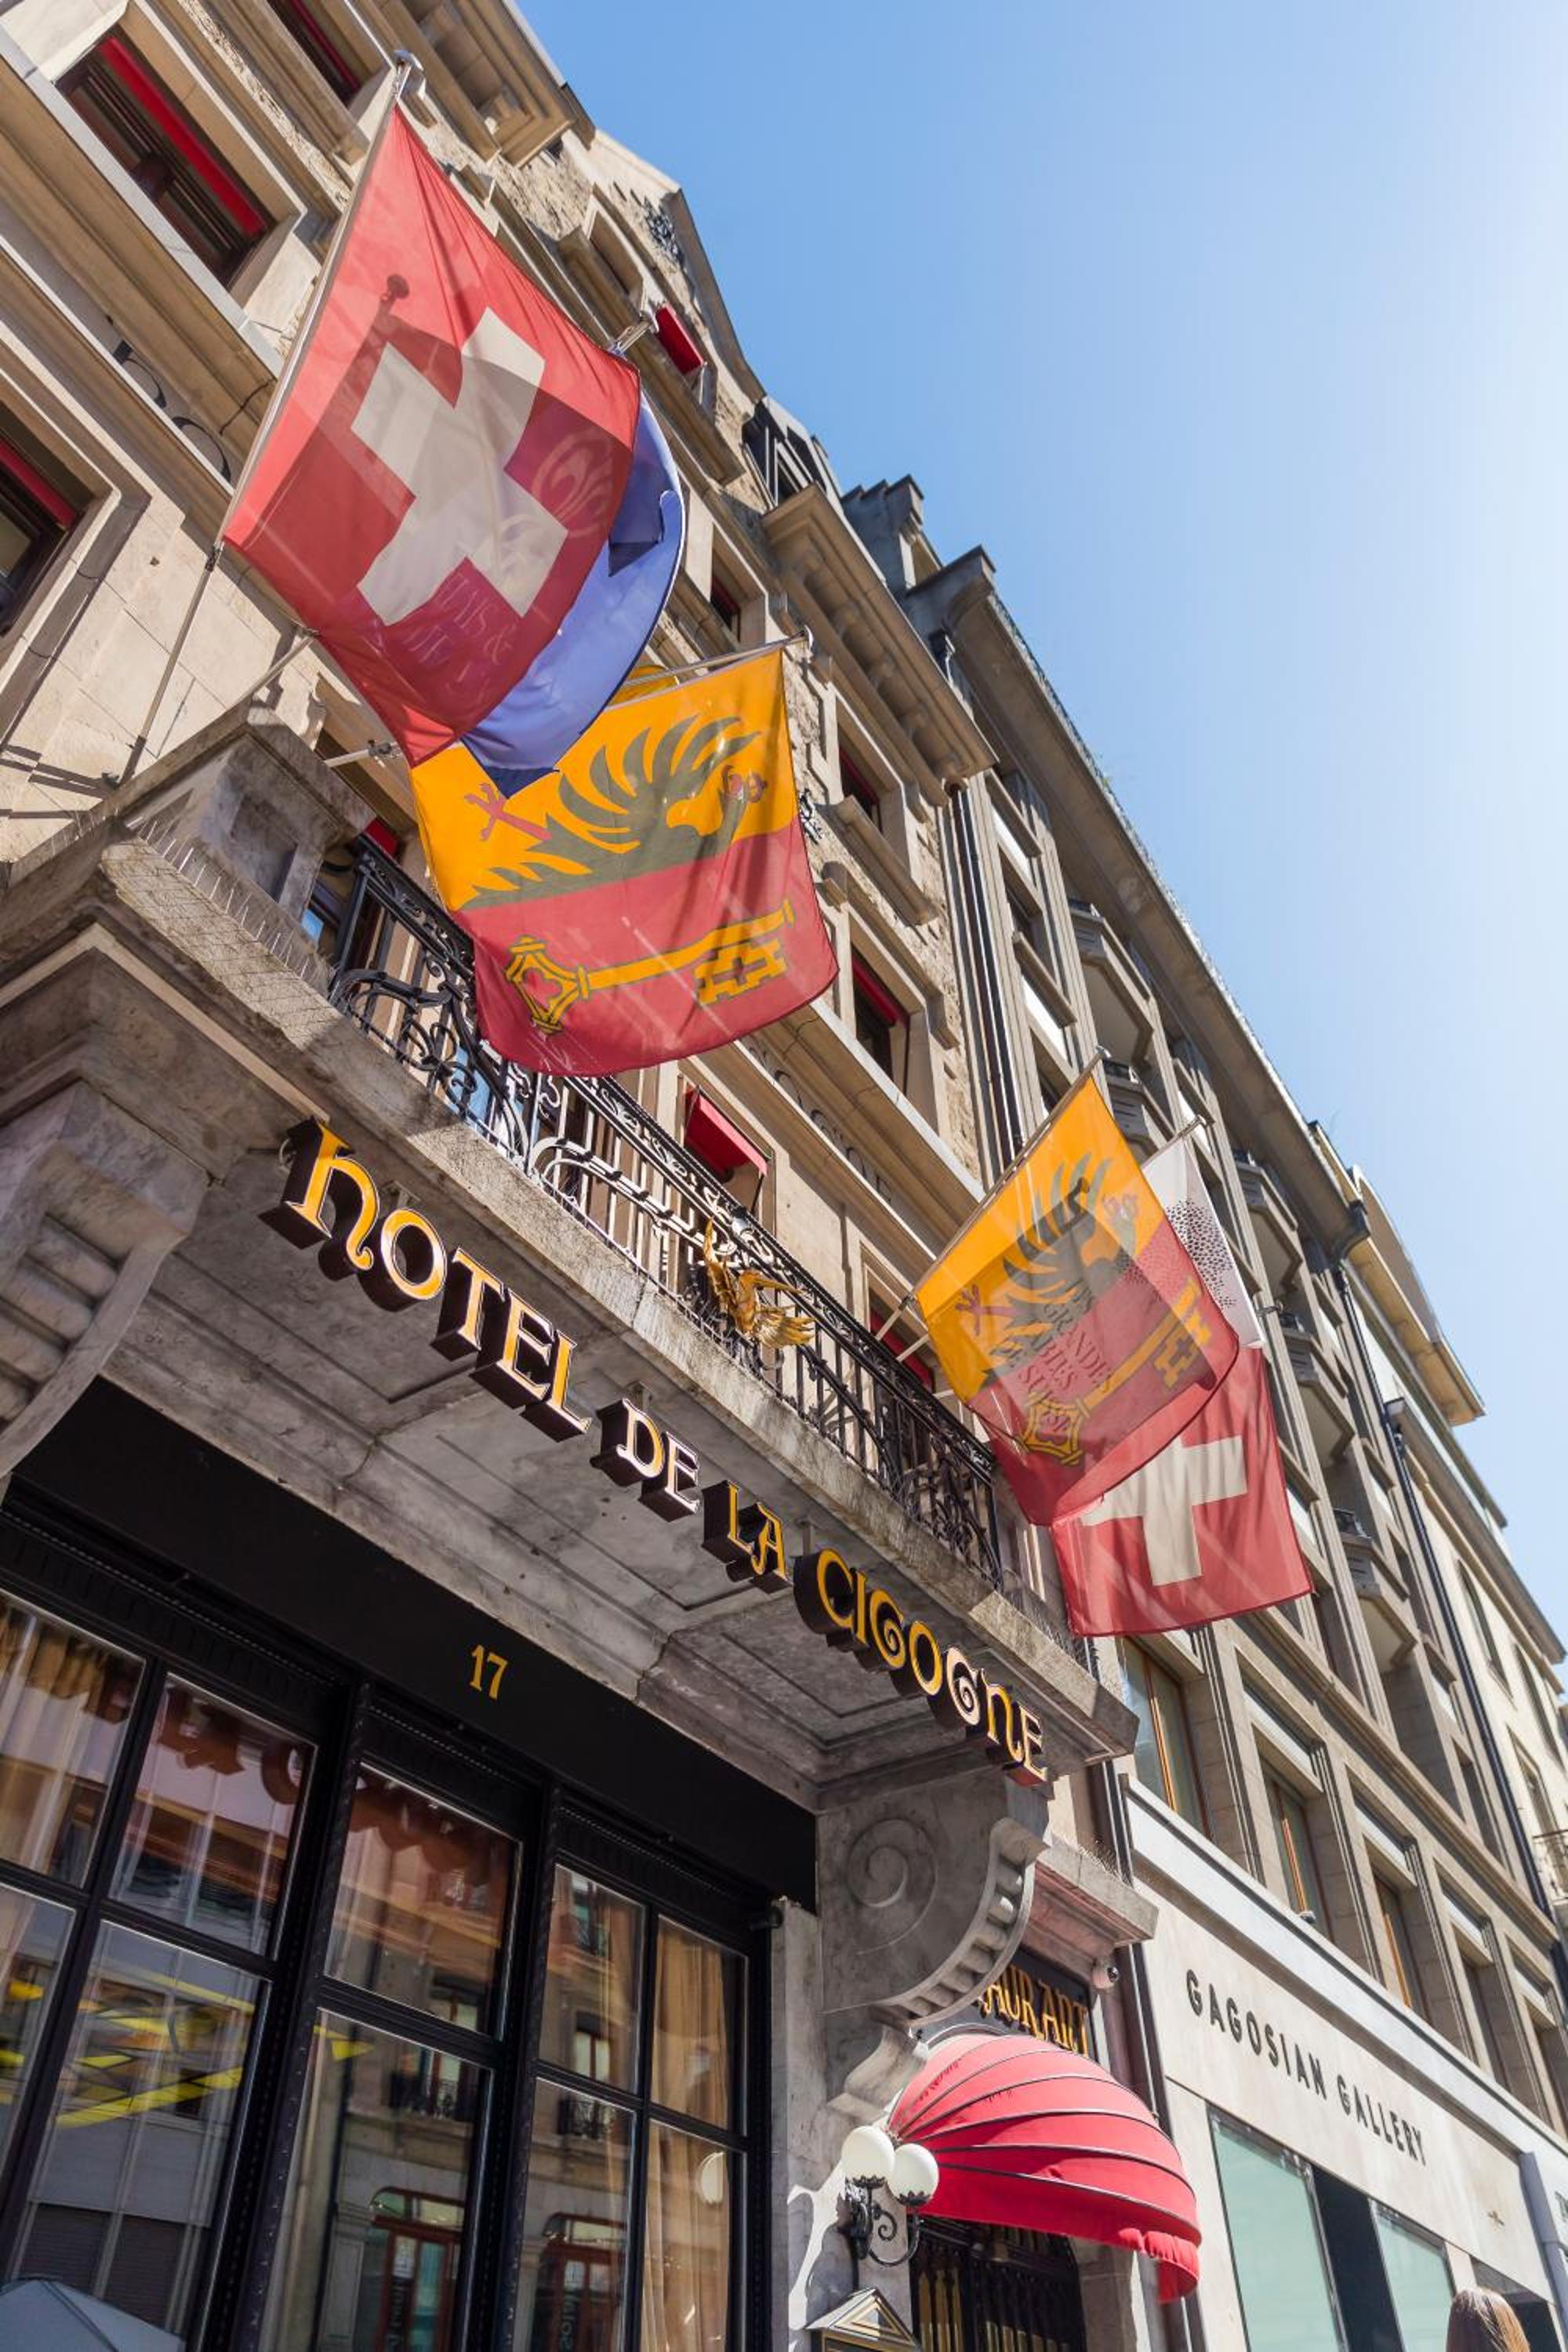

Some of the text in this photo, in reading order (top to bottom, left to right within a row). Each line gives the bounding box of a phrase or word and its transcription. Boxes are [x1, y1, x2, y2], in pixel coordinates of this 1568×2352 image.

[469, 1644, 508, 1700] 17
[616, 1398, 701, 1515] DE
[727, 1480, 793, 1586] LA
[816, 1548, 1049, 1782] CIGOGNE
[1186, 1969, 1427, 2166] GAGOSIAN GALLERY
